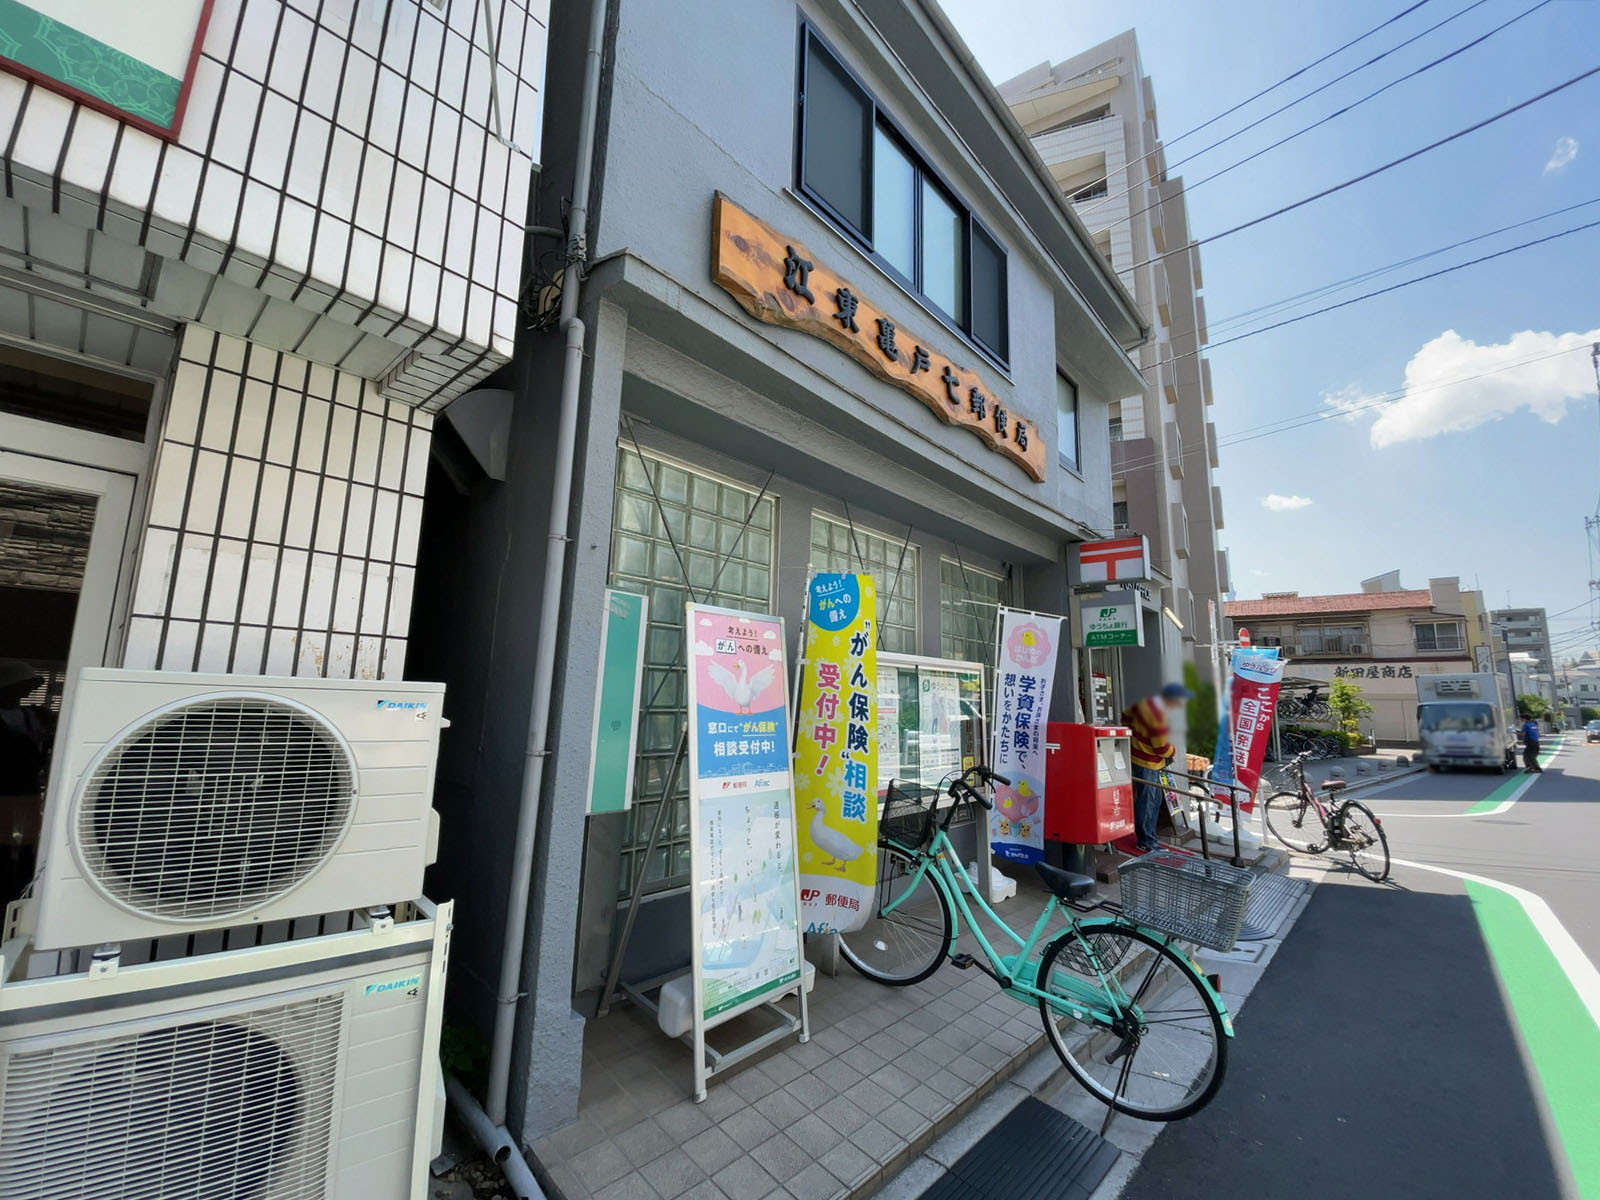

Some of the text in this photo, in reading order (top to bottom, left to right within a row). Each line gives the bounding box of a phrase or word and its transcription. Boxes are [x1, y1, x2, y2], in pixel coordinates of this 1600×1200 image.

[819, 593, 852, 611] がんへの
[1089, 621, 1128, 631] ゆうちょ銀行
[1090, 633, 1133, 641] ATMコーナー
[1242, 662, 1278, 674] ゆうパック
[1333, 665, 1413, 679] 新田屋商店
[387, 701, 428, 709] DAIKIN
[1256, 687, 1273, 731] ここから
[999, 673, 1017, 764] 想いをかたちに
[1235, 700, 1258, 766] 全国発送
[825, 893, 860, 912] 郵便局
[377, 977, 420, 993] DAIKIN
